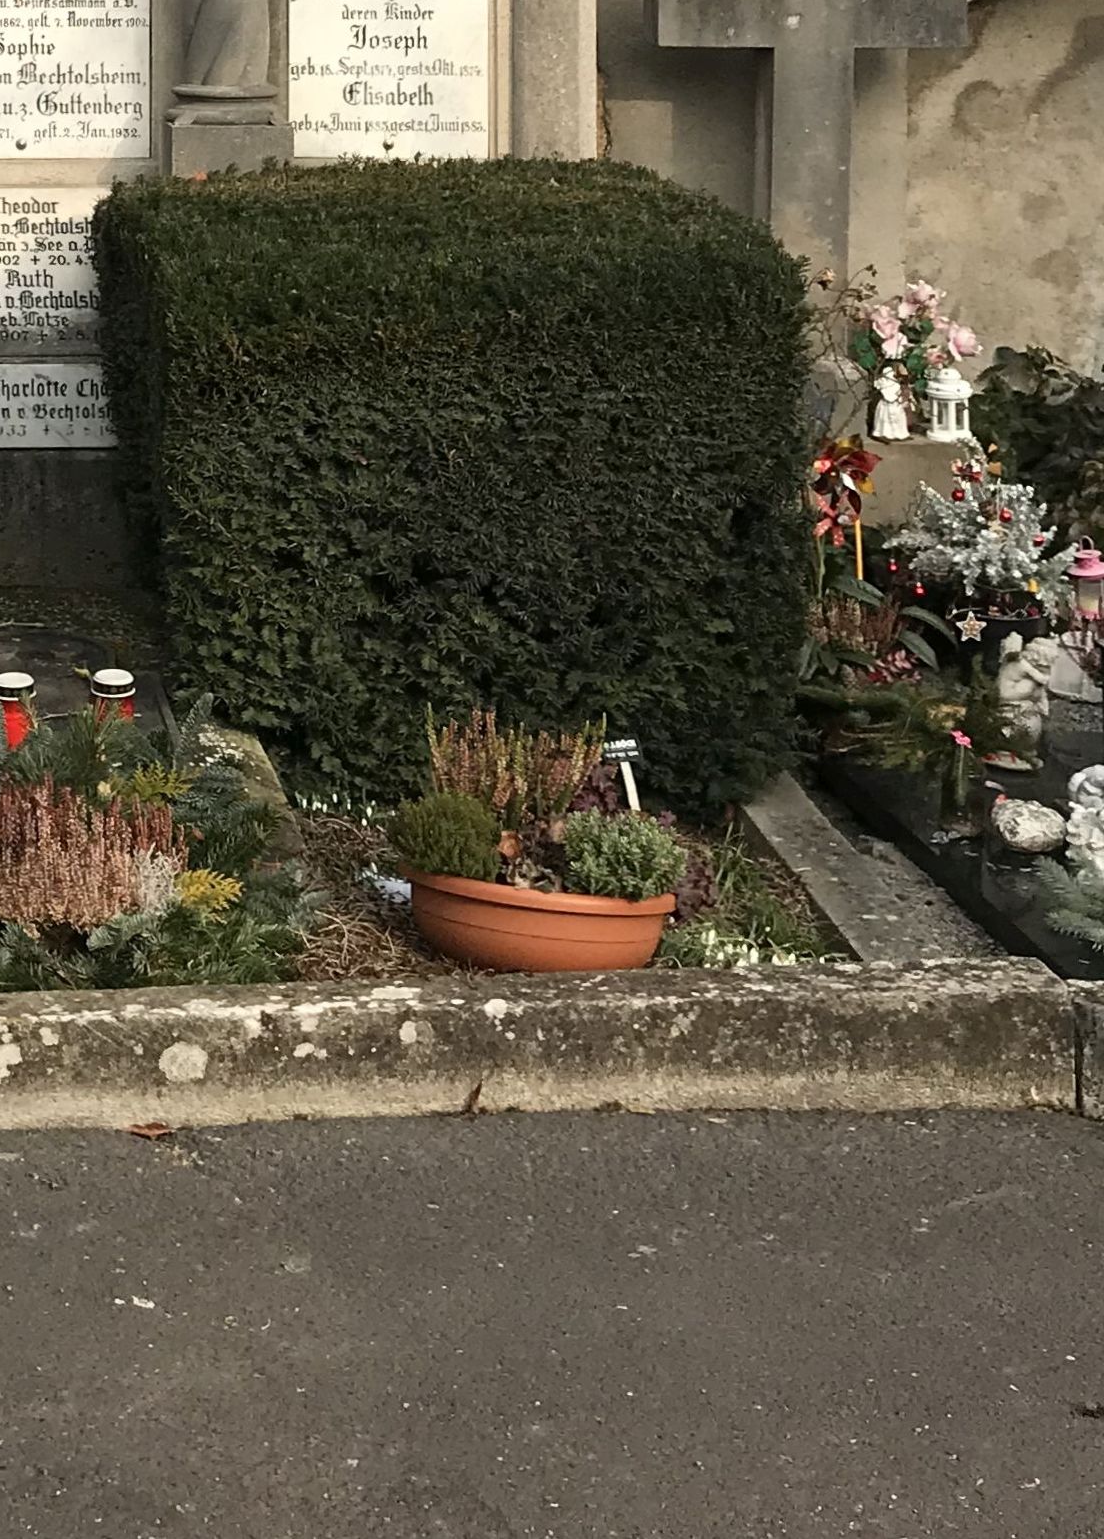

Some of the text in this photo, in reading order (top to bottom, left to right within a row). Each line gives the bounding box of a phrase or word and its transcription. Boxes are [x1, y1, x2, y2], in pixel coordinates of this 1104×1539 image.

[67, 11, 124, 29] November
[341, 2, 435, 21] deren Kinder
[347, 24, 428, 57] Joseph
[342, 81, 434, 106] Elisabeth
[36, 90, 143, 121] Guttenberg
[34, 237, 64, 254] See
[4, 268, 54, 289] Ruth
